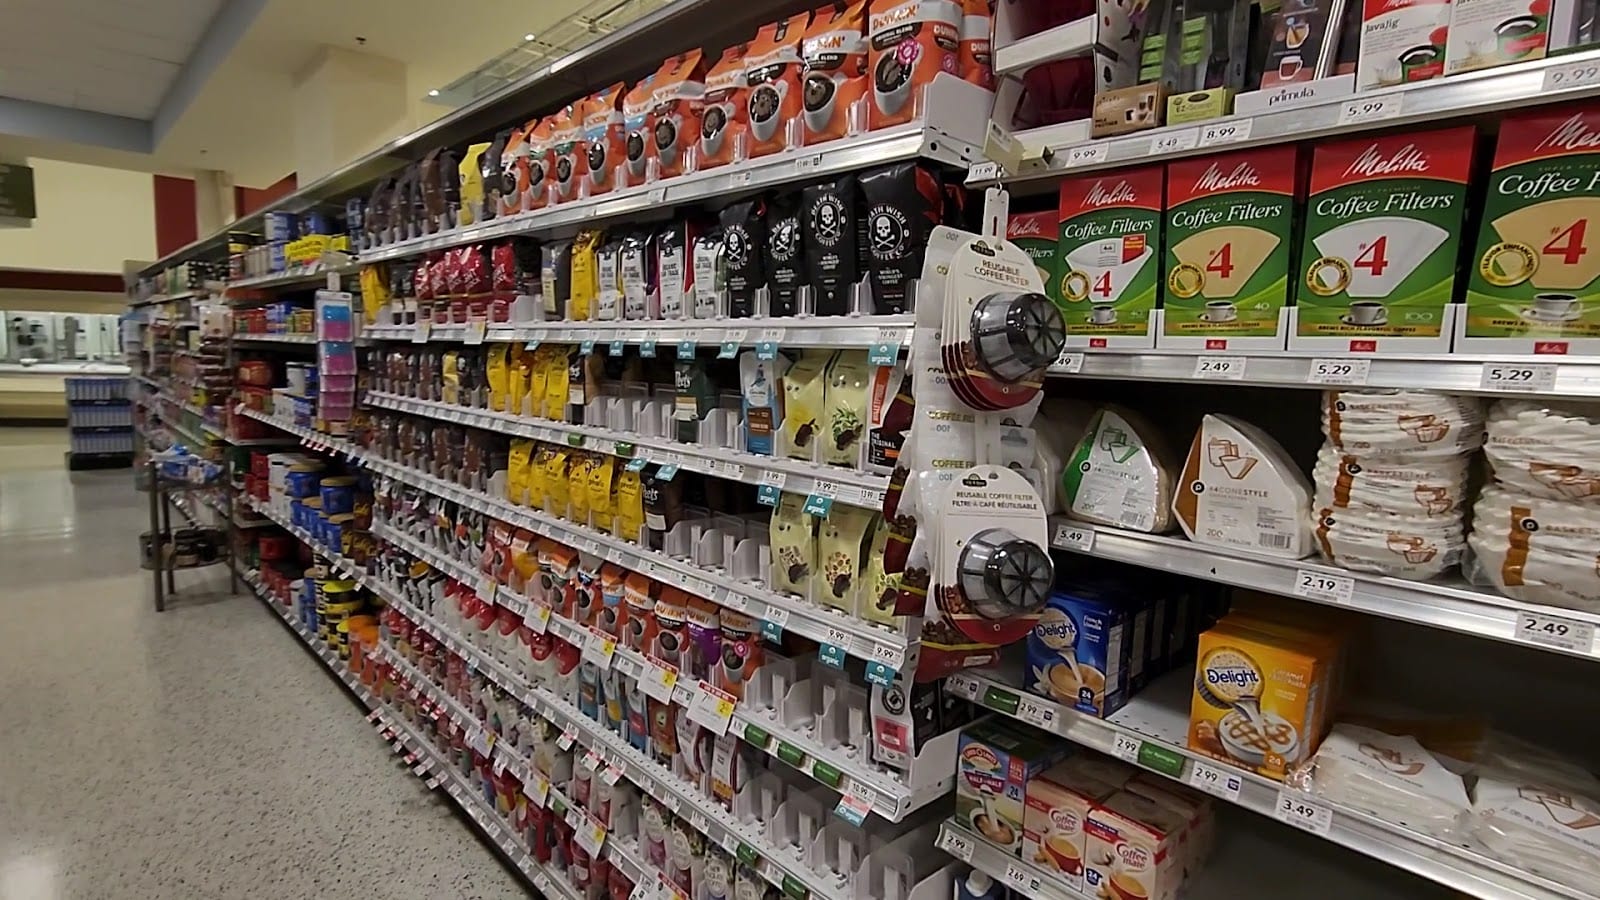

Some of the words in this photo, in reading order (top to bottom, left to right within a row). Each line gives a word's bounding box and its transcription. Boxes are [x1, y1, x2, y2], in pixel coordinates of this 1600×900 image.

[1365, 18, 1400, 34] JavaJig
[1552, 67, 1598, 84] 9.99
[1269, 87, 1315, 106] primula
[1348, 103, 1384, 117] 5.99
[1206, 127, 1236, 139] 8.99
[1157, 138, 1178, 149] 5.49
[1073, 150, 1097, 160] 9.99
[1342, 144, 1430, 178] Melitta
[1190, 161, 1261, 193] Melitta
[1498, 172, 1580, 198] Coffee
[1080, 180, 1137, 208] Melitta
[1315, 197, 1379, 219] Coffee
[1384, 191, 1455, 212] Filters
[885, 205, 907, 225] WISH
[1171, 209, 1223, 230] Coffee
[1227, 203, 1282, 222] Filters
[1064, 221, 1107, 240] Coffee
[1109, 218, 1154, 235] Filters
[982, 260, 1020, 276] REUSABLE
[974, 267, 1005, 281] COFFEE
[1006, 274, 1030, 286] FILTER
[1405, 312, 1433, 321] 100
[871, 355, 892, 365] organic
[1051, 357, 1071, 366] .49
[1201, 361, 1230, 372] 2.49
[1317, 364, 1352, 376] 5.29
[1491, 369, 1533, 382] 5.29
[929, 411, 962, 421] COFFEE
[932, 459, 965, 469] COFFEE
[816, 480, 832, 490] 9.99
[956, 491, 987, 499] REUSABLE
[952, 500, 972, 508] FILTRE
[1060, 530, 1083, 542] 5.49
[1303, 576, 1336, 591] 2.19
[1036, 623, 1076, 639] Delight
[1524, 618, 1569, 637] 2.49
[829, 629, 845, 641] 9.99
[877, 647, 894, 658] 9.99
[821, 654, 840, 667] organic
[868, 672, 889, 686] organic
[1206, 668, 1259, 687] Delight
[1081, 690, 1091, 699] 24
[1268, 755, 1282, 766] 24
[1010, 786, 1019, 798] 24
[1282, 800, 1314, 818] 3.49
[1051, 810, 1077, 827] Coffee
[947, 835, 966, 850] 2.99
[1116, 843, 1148, 862] Coffee
[1122, 858, 1146, 869] mate
[1008, 867, 1024, 882] 2.69
[1087, 870, 1098, 879] 24
